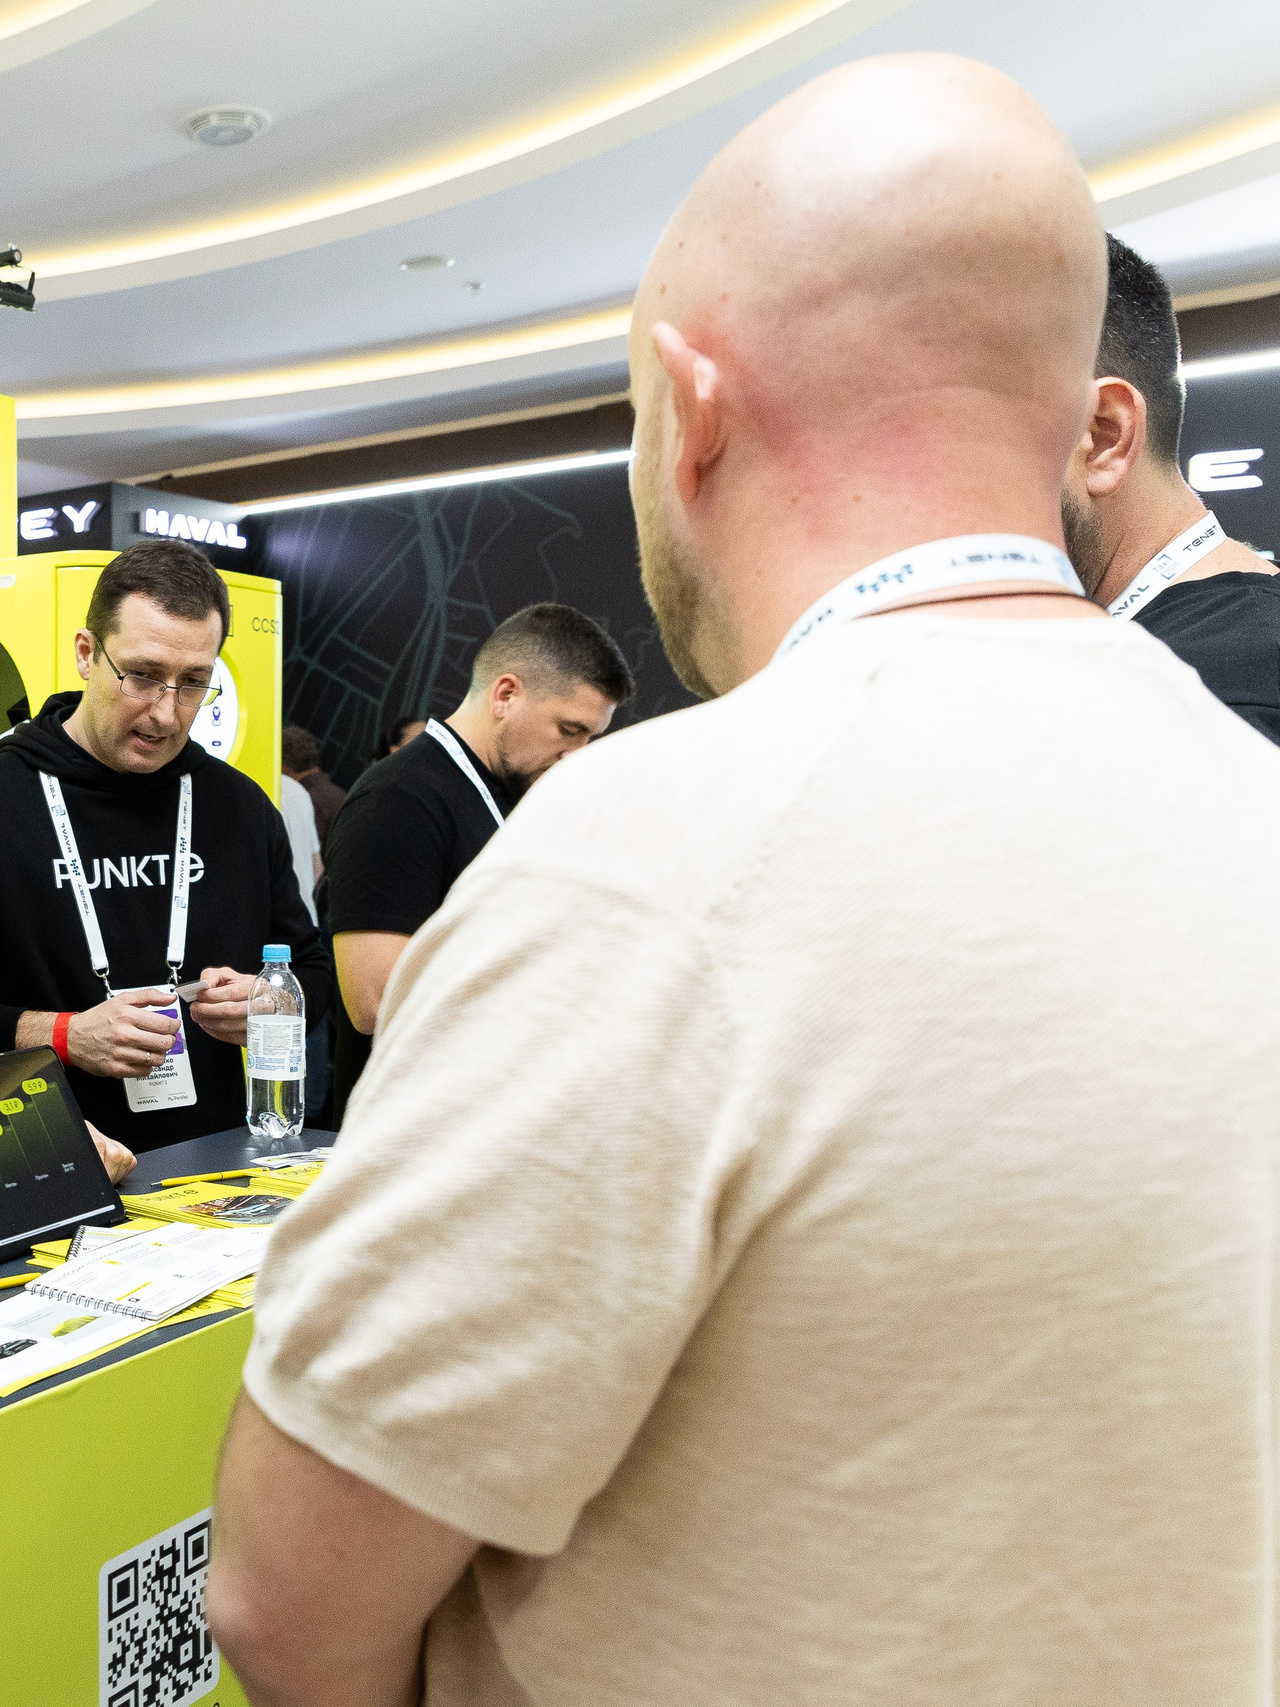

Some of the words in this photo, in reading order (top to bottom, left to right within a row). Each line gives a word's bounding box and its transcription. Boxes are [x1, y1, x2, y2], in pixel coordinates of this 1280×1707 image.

[19, 500, 98, 541] EY
[144, 508, 247, 549] HAVAL
[61, 823, 72, 853] HAVAL
[53, 855, 169, 889] PUNKT
